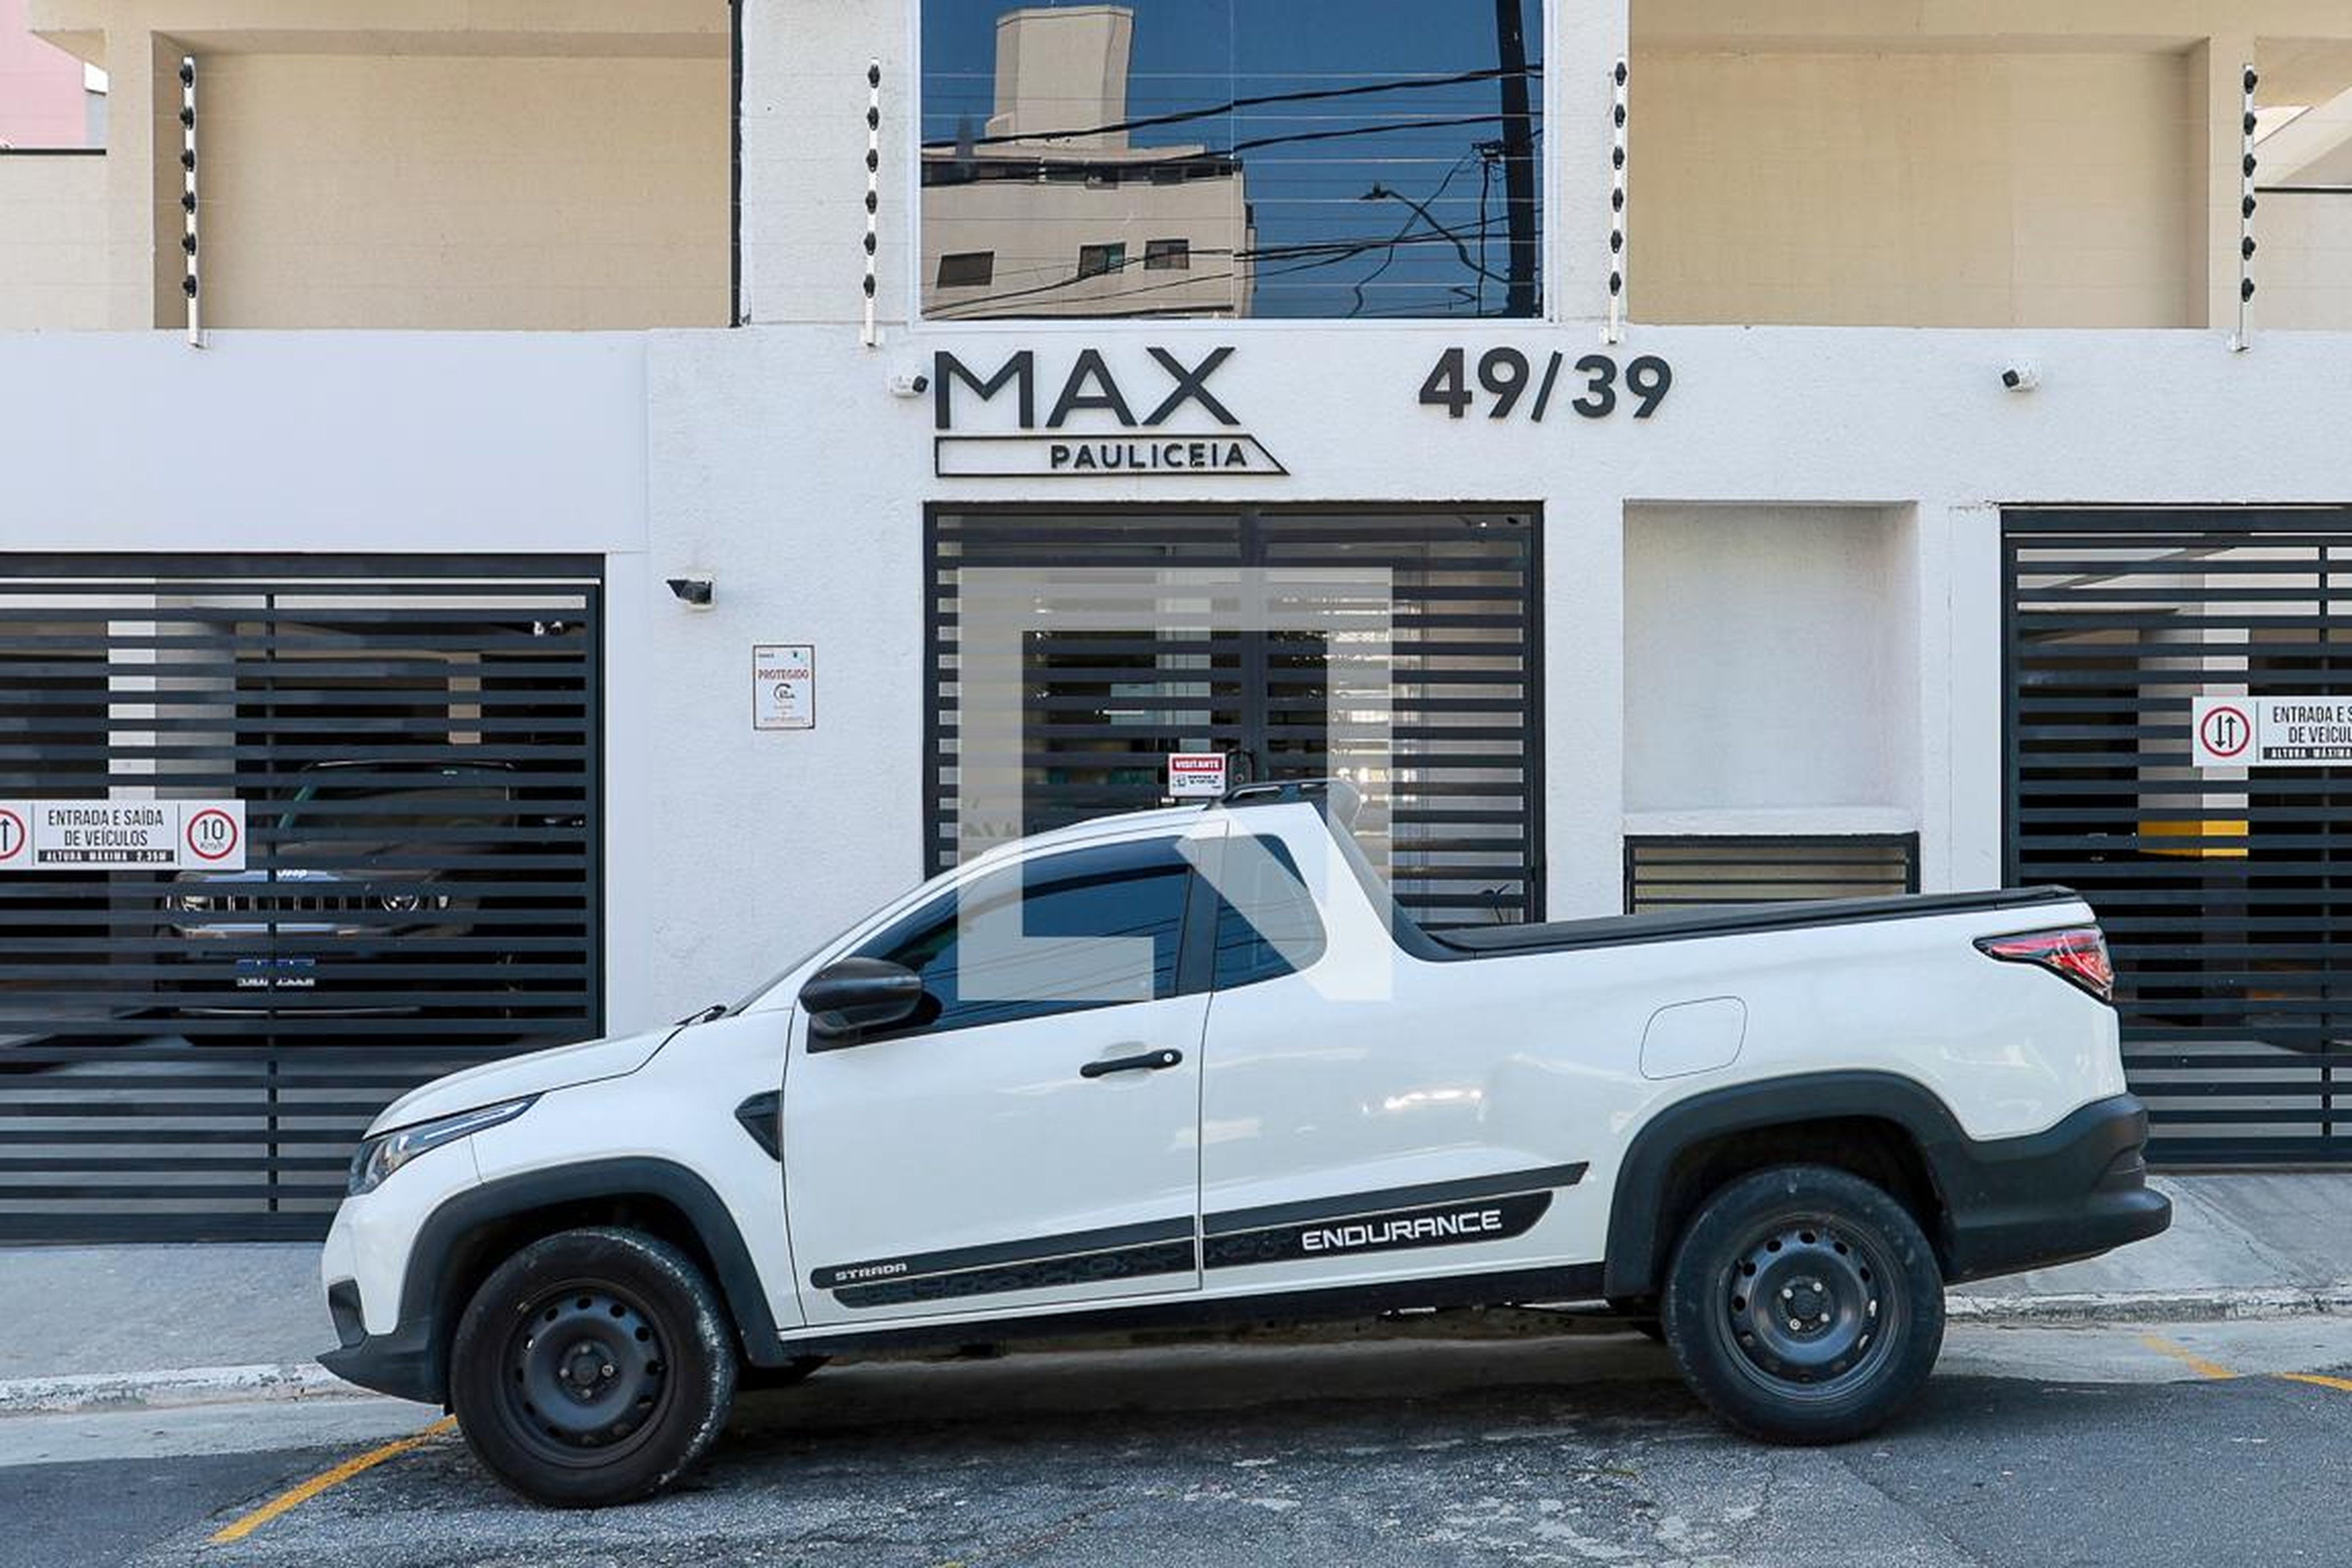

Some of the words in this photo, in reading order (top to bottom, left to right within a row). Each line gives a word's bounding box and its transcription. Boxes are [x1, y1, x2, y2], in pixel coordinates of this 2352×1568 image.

[935, 347, 1240, 429] MAX
[1419, 347, 1672, 423] 49/39
[1051, 443, 1247, 469] PAULICEIA
[758, 669, 809, 680] PROTEGIDO
[2274, 706, 2332, 723] ENTRADA
[2337, 706, 2344, 723] E
[2289, 726, 2305, 743] DE
[48, 810, 109, 826] ENTRADA
[113, 810, 120, 826] E
[124, 806, 164, 826] SAÍDA
[65, 830, 80, 846] DE
[85, 827, 148, 846] VEÍCULOS
[200, 818, 224, 840] 10
[1302, 1210, 1502, 1250] ENDURANCE
[835, 1262, 907, 1281] STRADA
